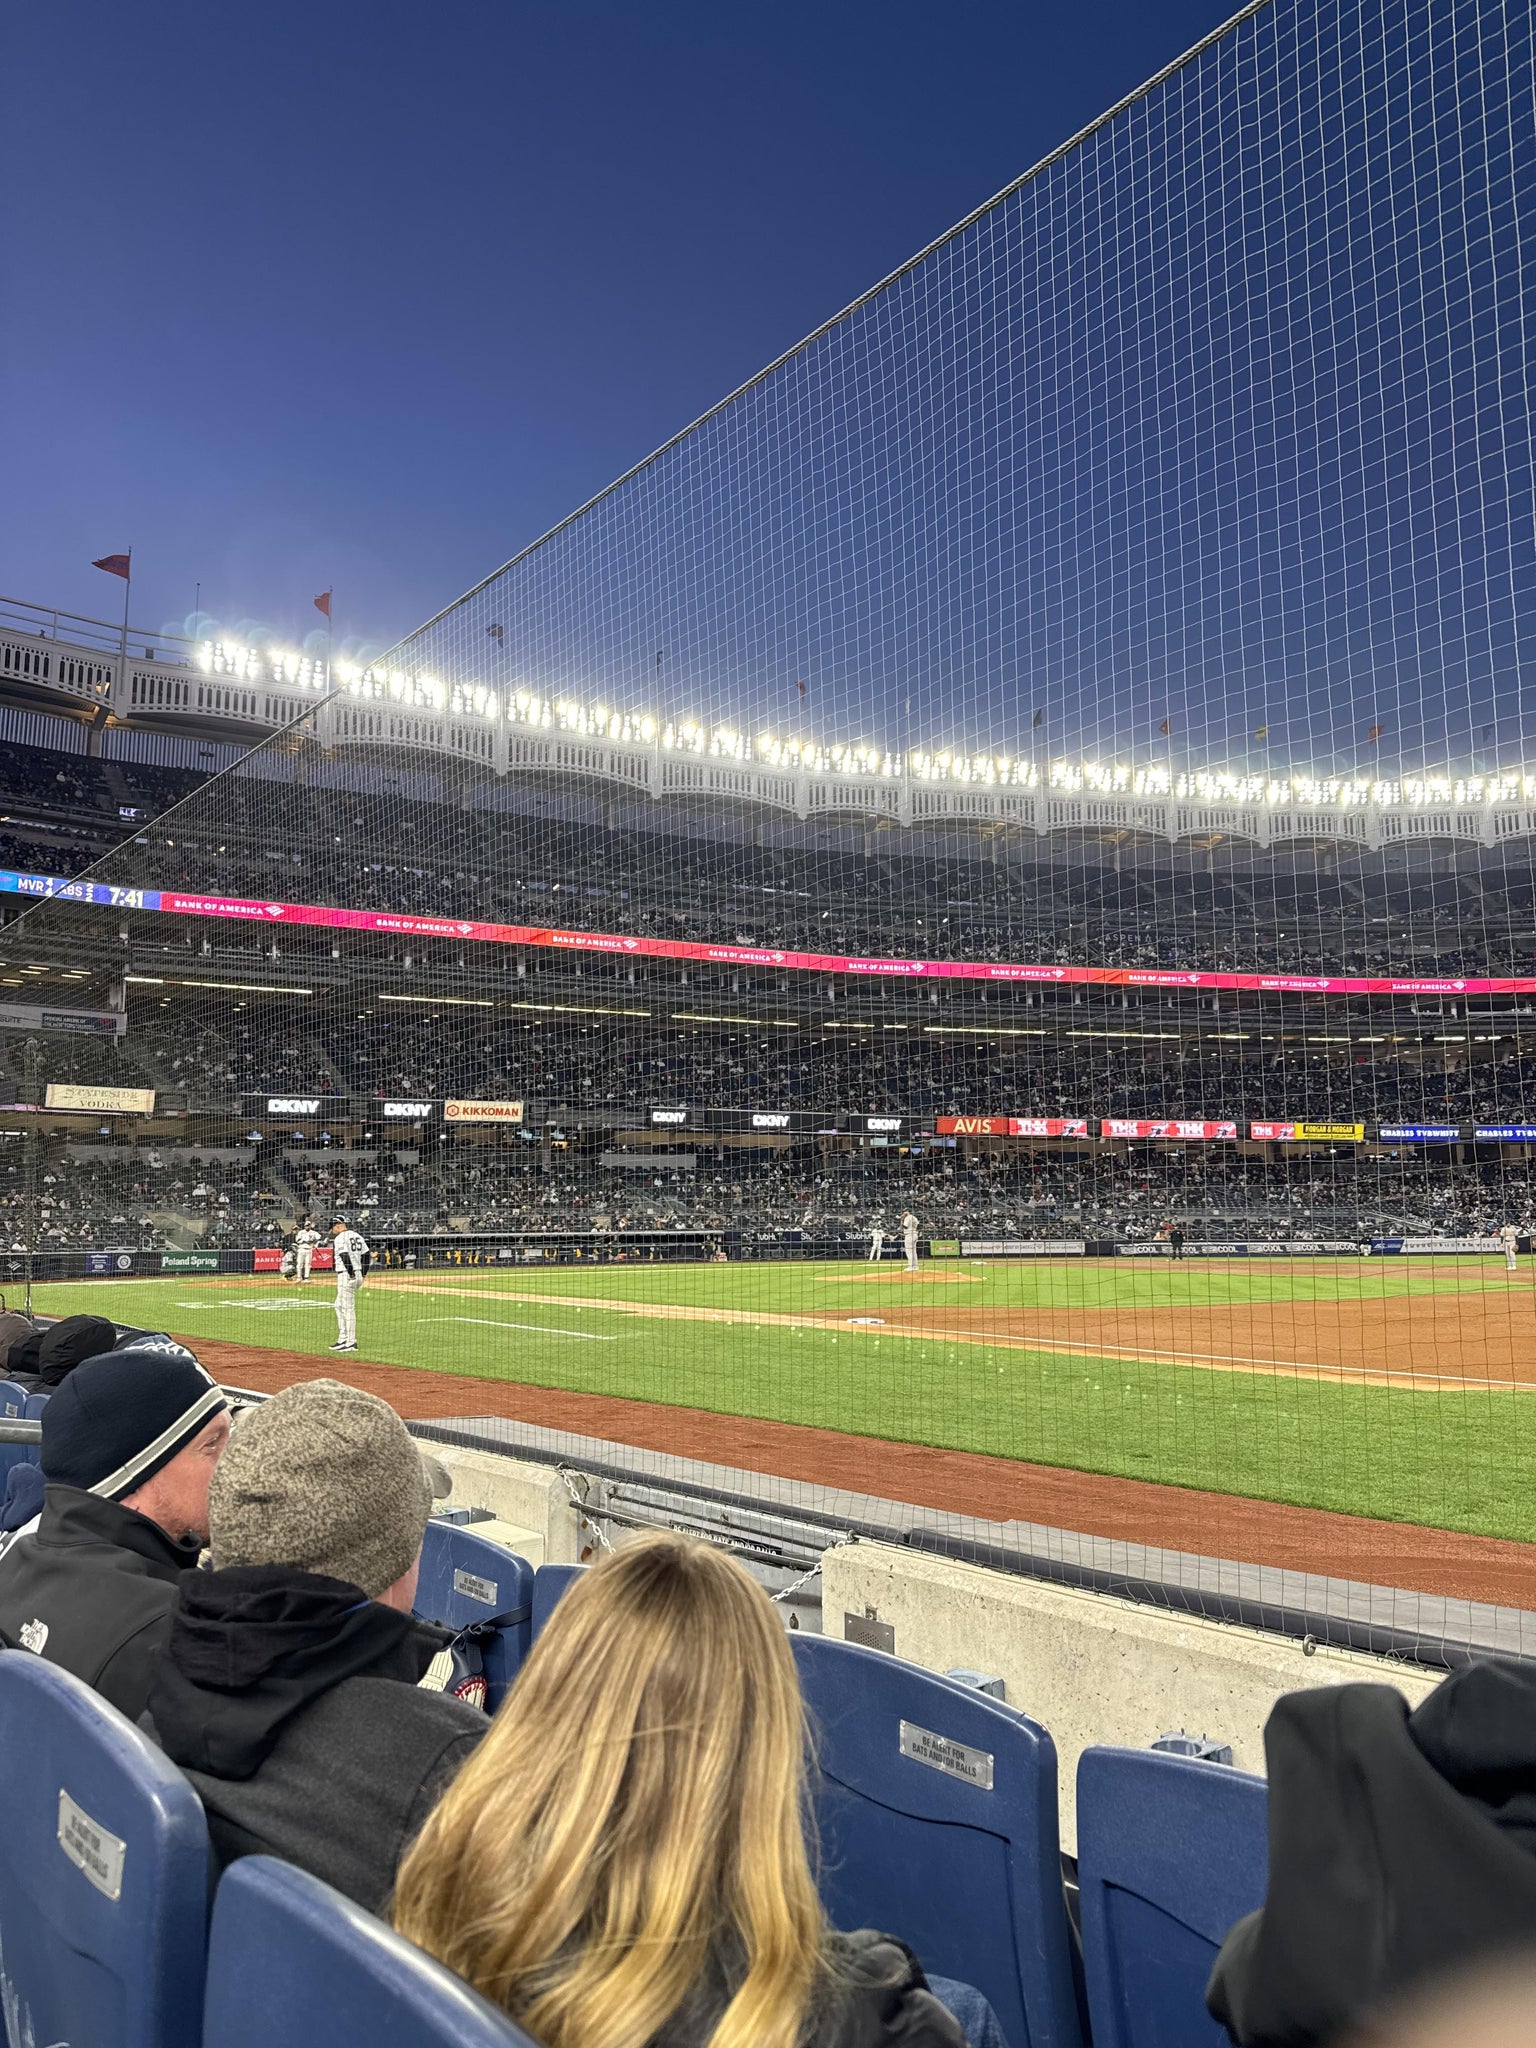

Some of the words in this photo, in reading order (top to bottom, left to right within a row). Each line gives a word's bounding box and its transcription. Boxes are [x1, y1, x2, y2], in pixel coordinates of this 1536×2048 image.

[18, 878, 44, 891] MVR
[60, 884, 83, 896] ABS
[86, 883, 94, 893] 2
[109, 887, 144, 907] 7:41
[174, 900, 202, 910] BANK
[218, 904, 263, 915] AMERICA
[376, 919, 401, 928] BANK
[402, 921, 415, 929] OF
[415, 923, 455, 933] AMERICA
[552, 935, 575, 944] BANK
[575, 937, 586, 945] OF
[587, 939, 622, 948] AMERICA
[65, 1087, 138, 1099] STATESIDE
[80, 1100, 121, 1109] VODKA
[268, 1099, 319, 1113] DKNY
[384, 1103, 432, 1116] DKNY
[462, 1106, 519, 1116] KIKKOMAN
[652, 1111, 686, 1122] DKNY
[752, 1114, 790, 1126] DKNY
[868, 1119, 901, 1130] DKNY
[953, 1118, 992, 1133] AVIS
[349, 1237, 363, 1252] 85
[162, 1256, 190, 1267] Poland
[190, 1256, 217, 1267] Spring
[922, 1736, 930, 1747] BE
[932, 1740, 951, 1756] ALERT
[952, 1748, 965, 1761] FOR
[912, 1742, 927, 1757] BATS
[929, 1750, 954, 1768] AND/OR
[955, 1760, 977, 1777] BALLS
